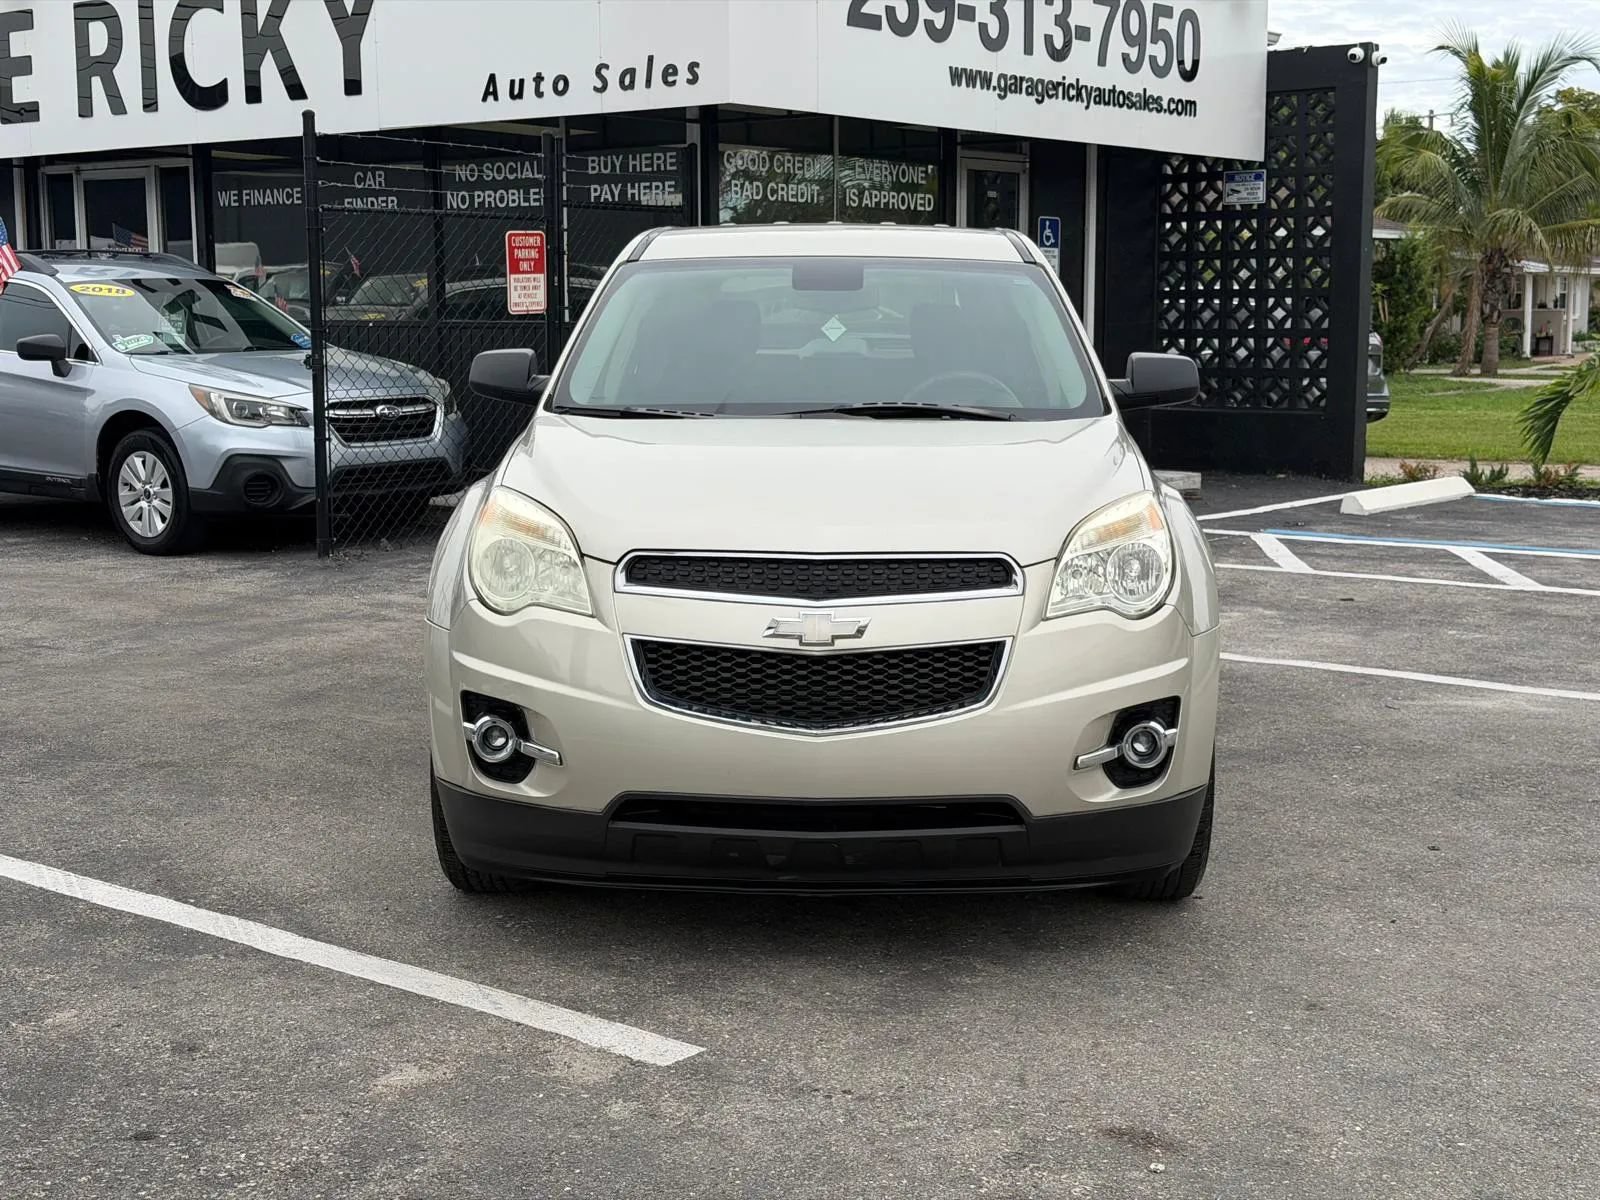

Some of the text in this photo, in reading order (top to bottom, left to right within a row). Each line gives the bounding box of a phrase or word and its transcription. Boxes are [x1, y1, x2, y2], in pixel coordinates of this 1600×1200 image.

[73, 0, 374, 118] RICKY
[481, 54, 701, 103] Auto Sales
[949, 65, 1197, 118] www.garagerickyautosales.com
[455, 159, 543, 182] NO SOCIAL
[588, 152, 678, 174] BUY HERE
[723, 150, 770, 172] GOOD
[354, 171, 386, 188] CAR
[855, 160, 927, 185] EVERYONE
[218, 187, 302, 207] WE FINANCE
[446, 188, 544, 210] NO PROBLE
[590, 184, 623, 203] PAY
[627, 181, 676, 201] HERE
[731, 180, 820, 205] BAD CREDIT
[845, 188, 934, 212] IS APPROVED
[511, 236, 541, 247] CUSTOMER
[514, 248, 539, 259] PARKING
[519, 260, 535, 272] ONLY
[79, 285, 127, 294] 2018
